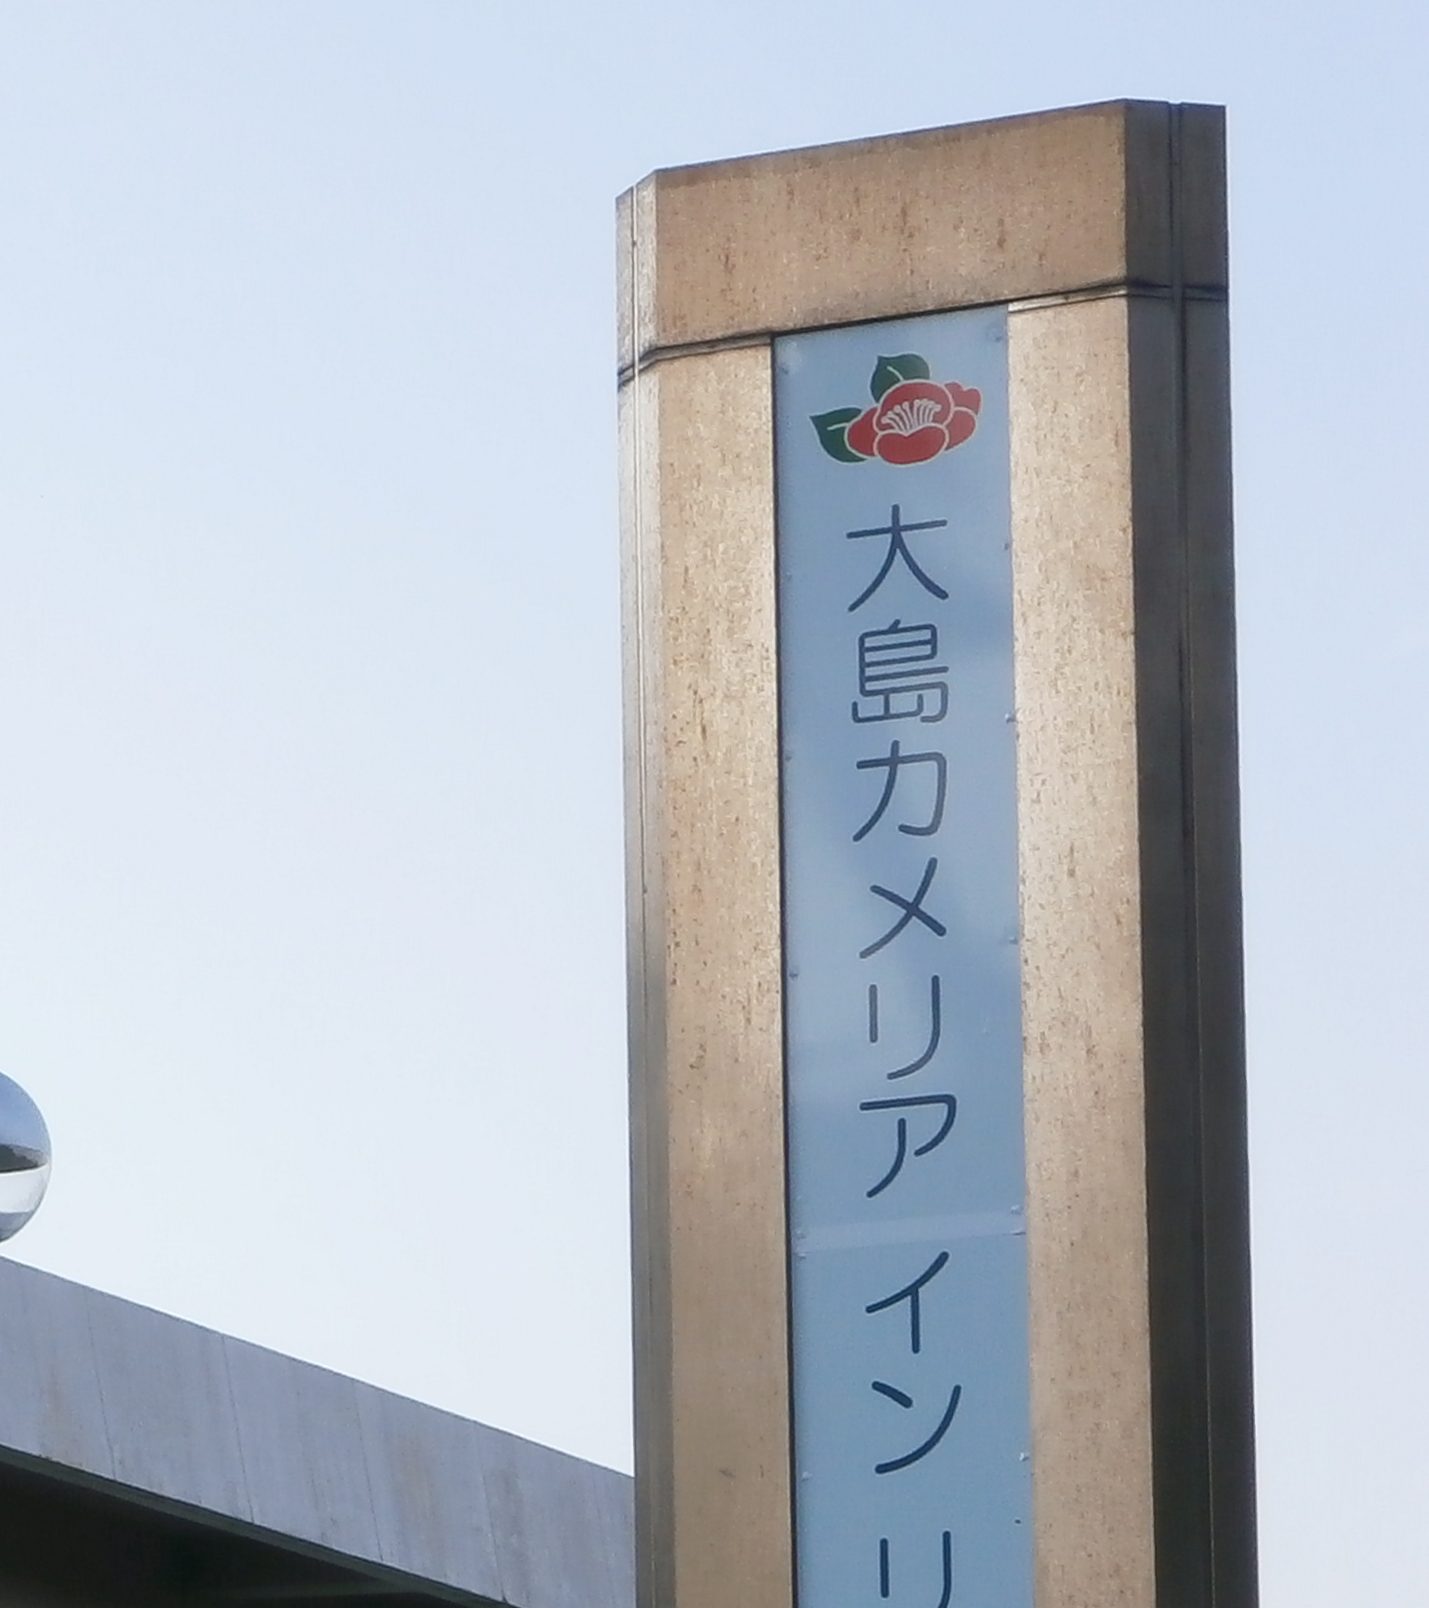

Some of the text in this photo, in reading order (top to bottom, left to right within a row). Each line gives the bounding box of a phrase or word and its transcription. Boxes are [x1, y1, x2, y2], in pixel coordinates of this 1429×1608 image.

[846, 504, 958, 1199] 大島カメリア
[865, 1251, 962, 1475] イン
